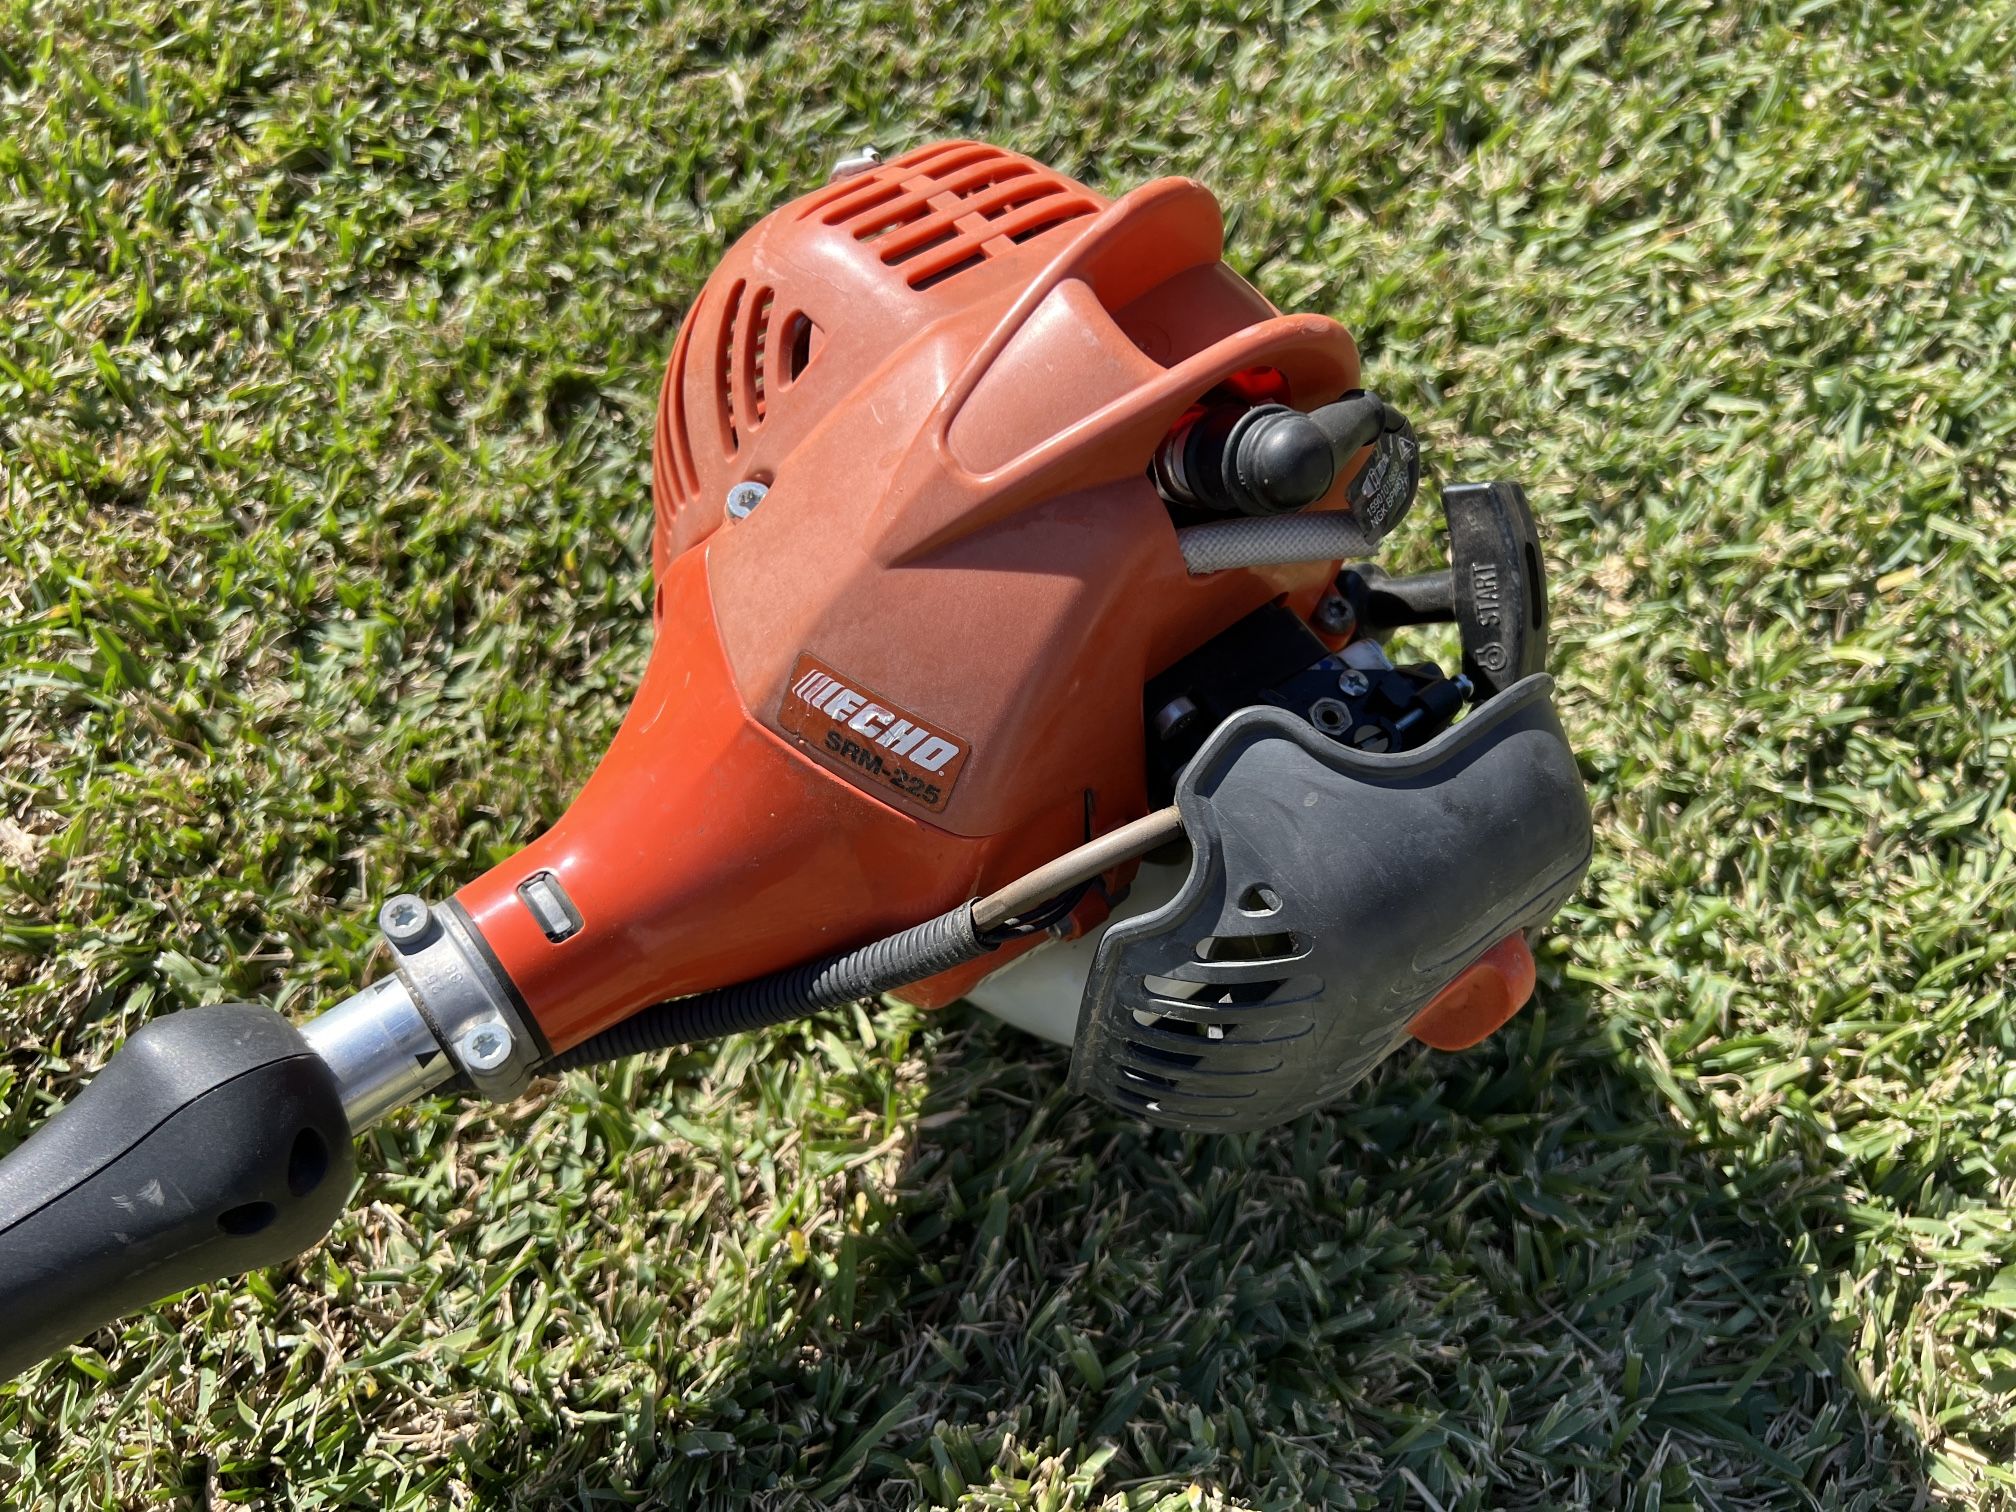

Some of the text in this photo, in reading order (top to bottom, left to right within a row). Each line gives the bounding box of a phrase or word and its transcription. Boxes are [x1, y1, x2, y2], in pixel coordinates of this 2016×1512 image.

[1371, 507, 1388, 528] NGK
[1472, 562, 1500, 627] START
[822, 688, 960, 772] ECHO
[825, 731, 941, 804] SRM-225
